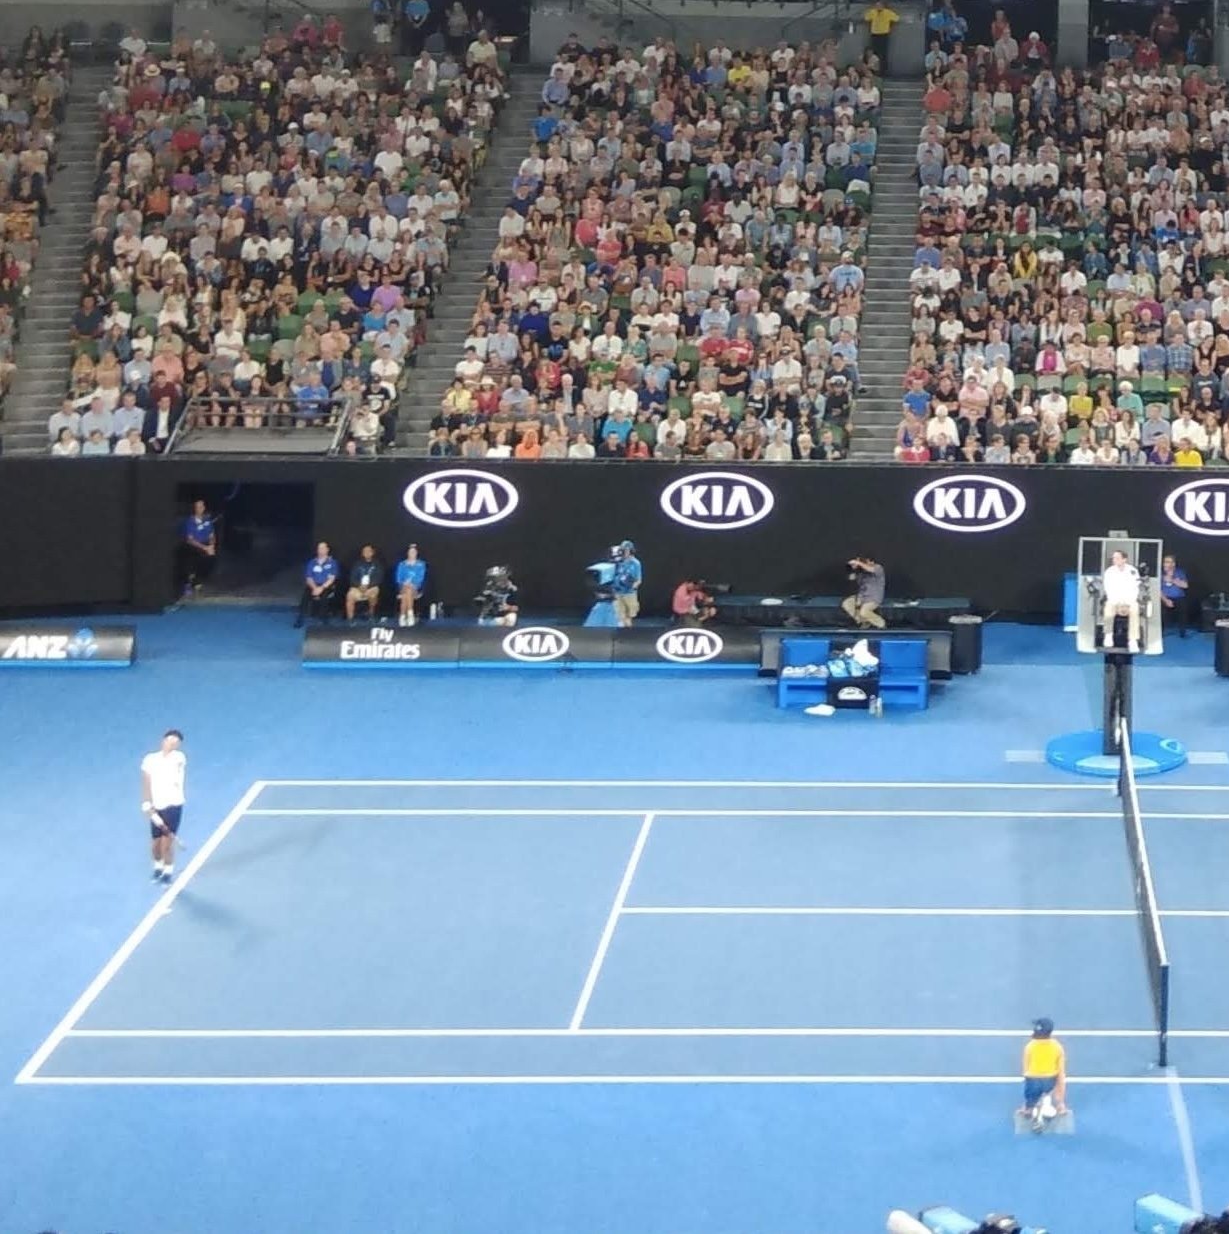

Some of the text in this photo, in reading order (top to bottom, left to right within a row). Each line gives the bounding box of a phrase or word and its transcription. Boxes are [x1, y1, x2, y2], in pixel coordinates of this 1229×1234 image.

[422, 481, 499, 514] KIA
[680, 484, 756, 517] KIA
[933, 487, 1008, 519] KIA
[370, 627, 395, 642] Fly
[513, 634, 558, 656] KIA
[667, 635, 712, 656] KIA
[1, 634, 69, 659] ANZ
[340, 640, 421, 659] Emirates
